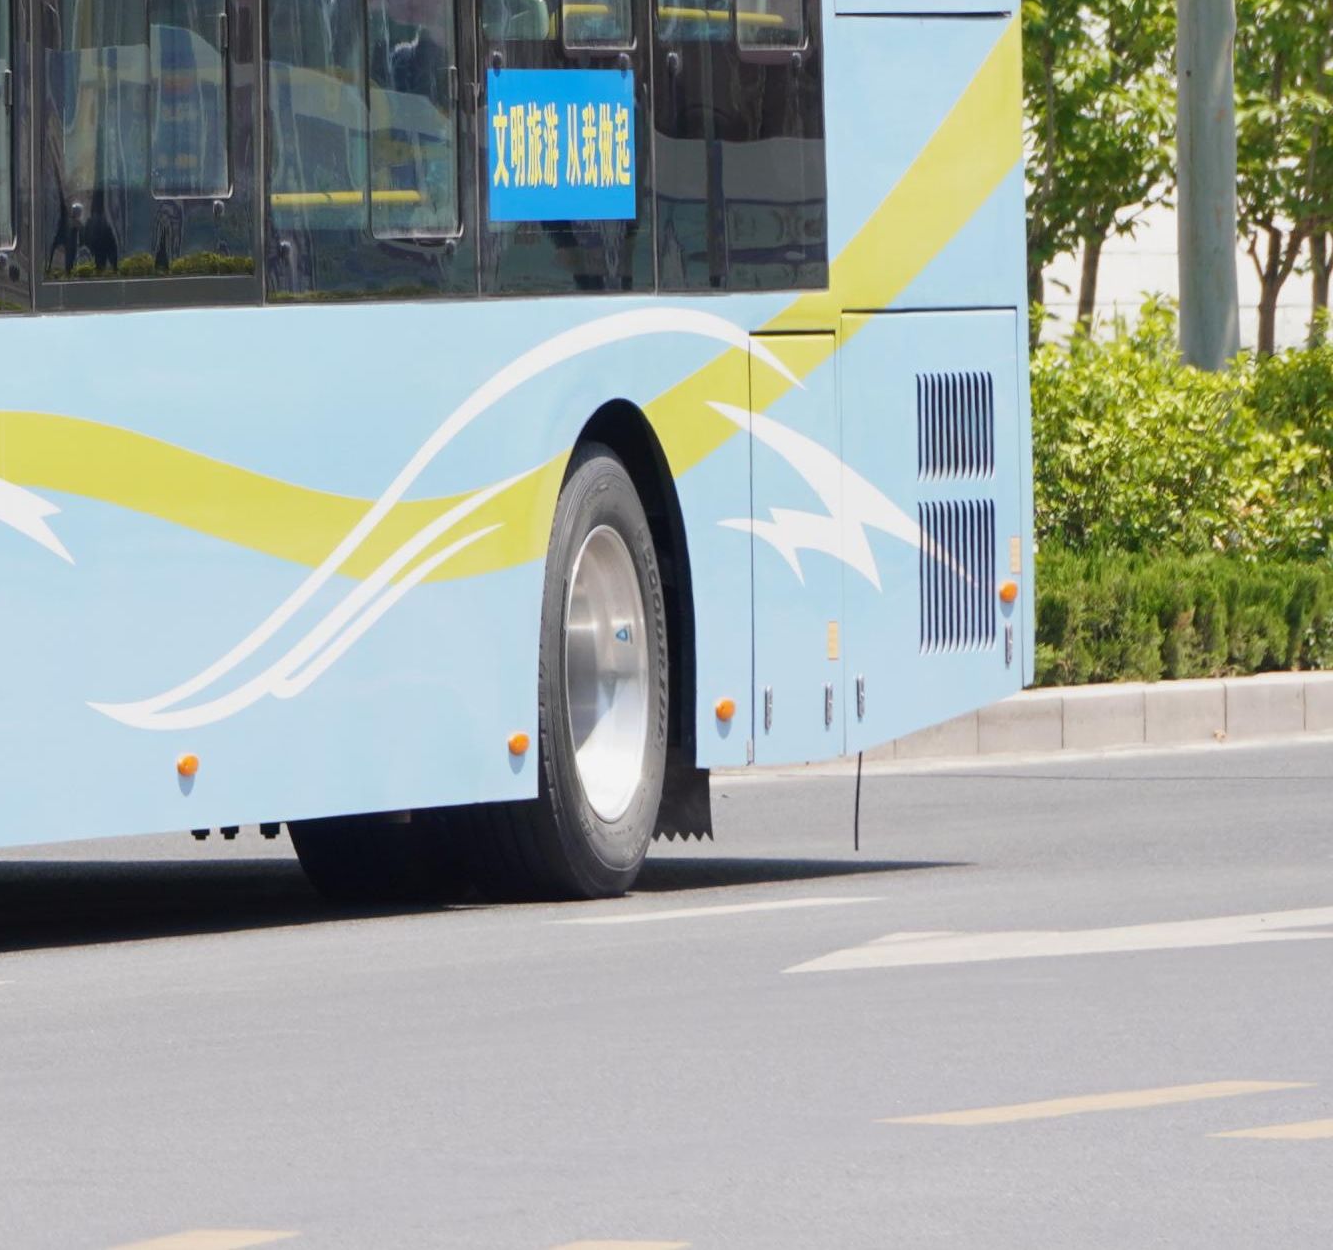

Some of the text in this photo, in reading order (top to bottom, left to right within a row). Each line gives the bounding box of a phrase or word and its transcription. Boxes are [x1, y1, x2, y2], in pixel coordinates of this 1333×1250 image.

[492, 100, 631, 189] 文明旅游 从我做起
